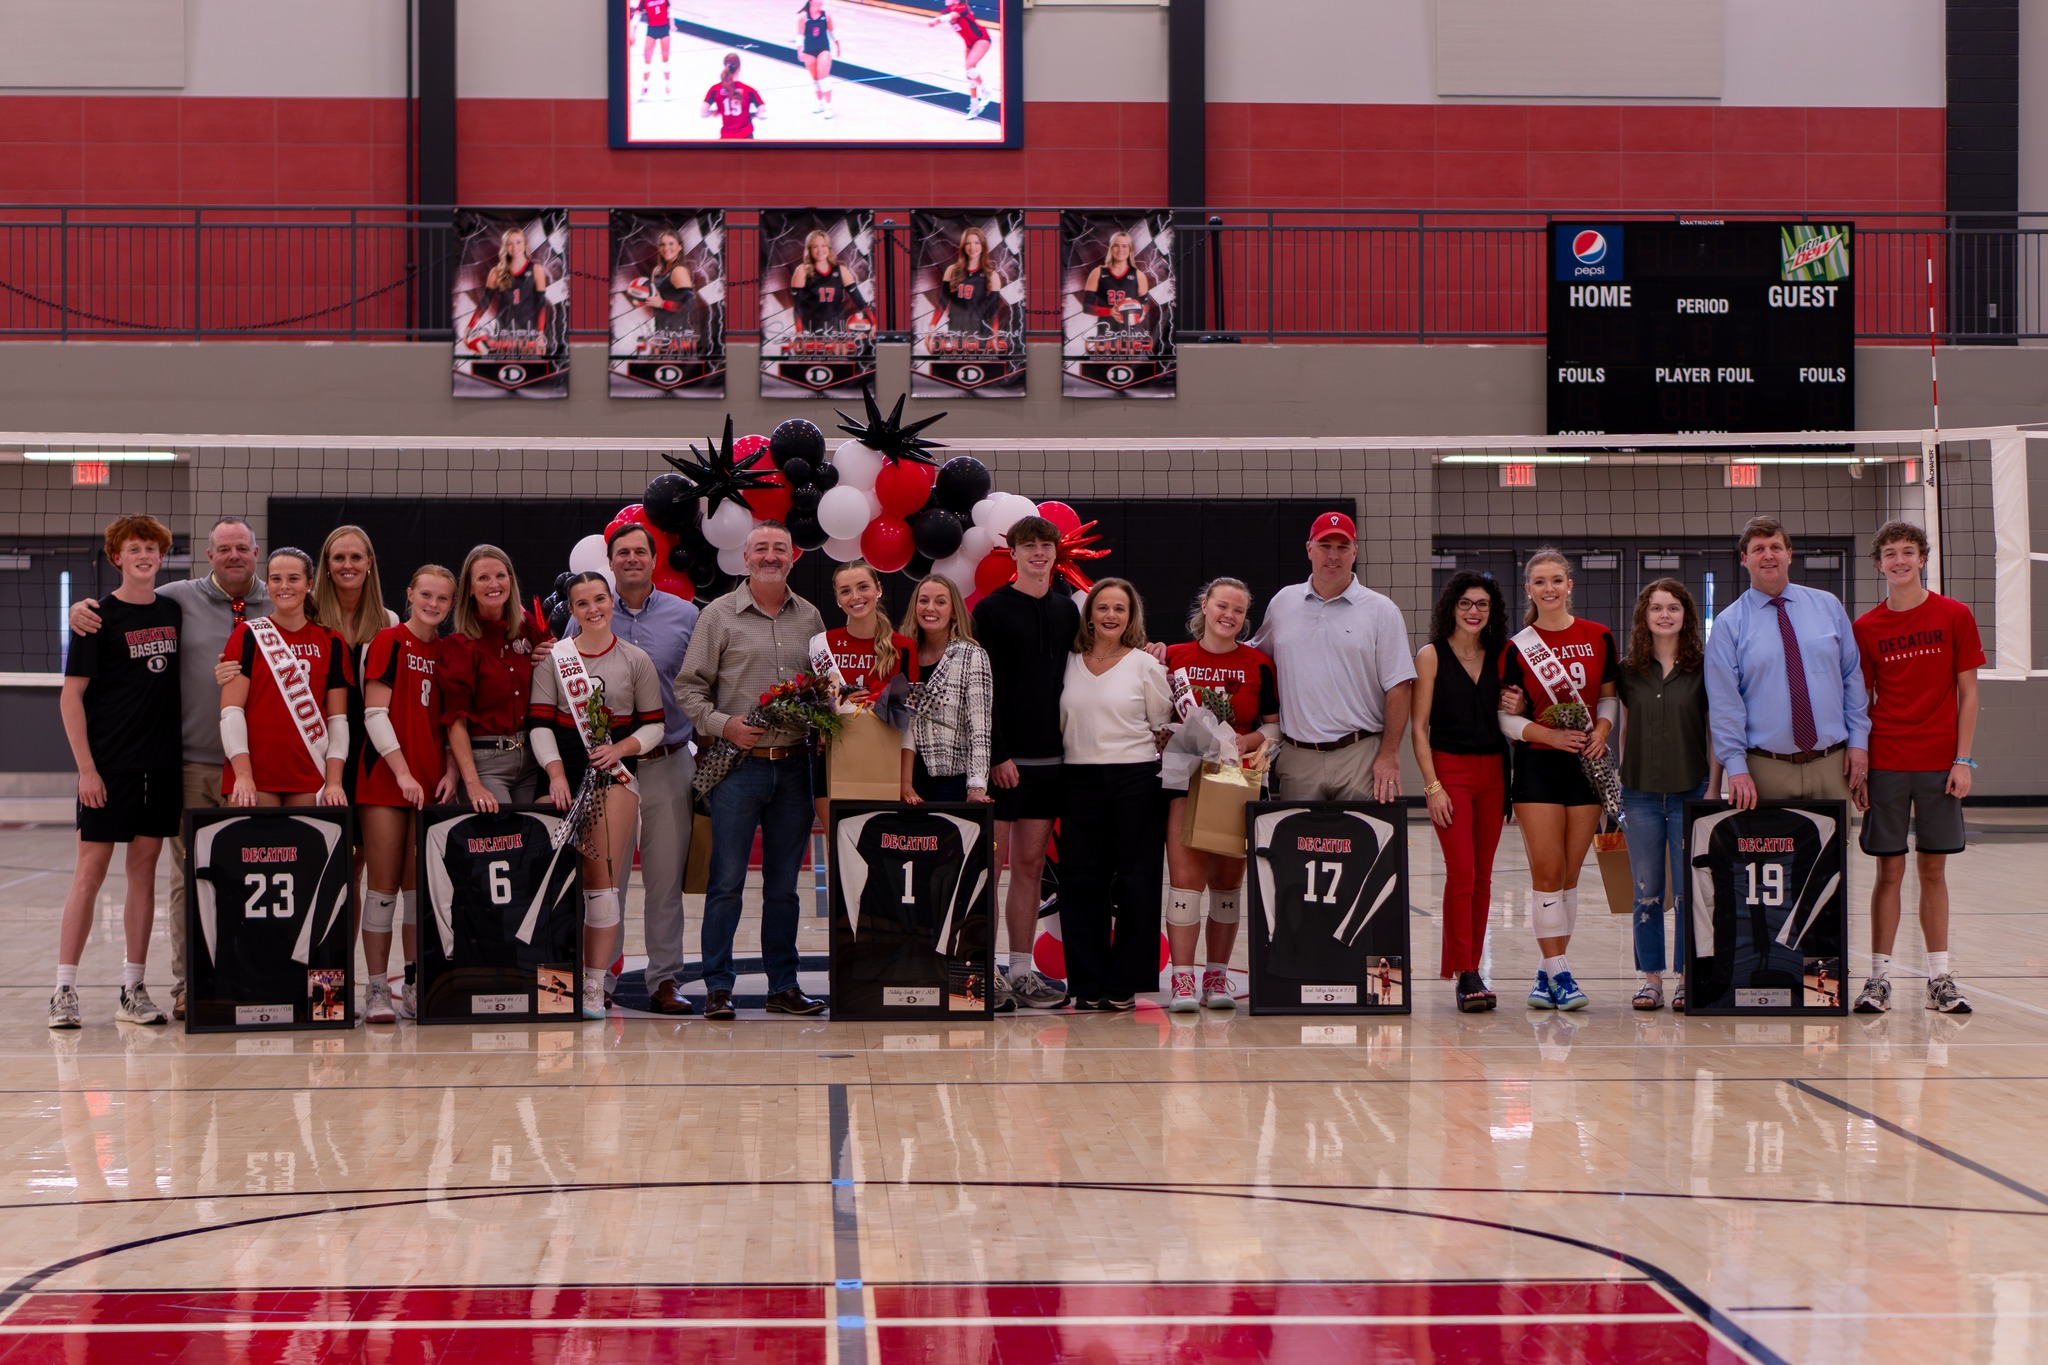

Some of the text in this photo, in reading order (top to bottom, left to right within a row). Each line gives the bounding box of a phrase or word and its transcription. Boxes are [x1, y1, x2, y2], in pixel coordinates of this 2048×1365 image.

[1574, 265, 1605, 276] pepsi
[818, 287, 835, 303] 17
[957, 283, 975, 299] 19
[1569, 285, 1632, 307] HOME
[1768, 285, 1839, 308] GUEST
[1676, 298, 1729, 314] PERIOD
[931, 335, 1008, 356] DOUGLAS
[1558, 367, 1606, 383] FOULS
[1655, 367, 1755, 383] PLAYER FOUL
[1799, 367, 1847, 383] FOULS
[77, 461, 104, 484] EXIT
[1506, 465, 1532, 486] EXIT
[1731, 465, 1757, 486] EXIT
[1523, 642, 1542, 655] CLASS
[1877, 629, 1944, 654] DECATUR
[290, 643, 321, 658] ATUR
[1552, 643, 1595, 660] CATUR
[1884, 647, 1942, 662] BASKETBALL
[557, 656, 578, 664] CLASS
[560, 665, 584, 679] 2026
[260, 632, 326, 745] SENIOR
[421, 678, 432, 707] 8
[468, 833, 523, 853] DECATUR
[881, 833, 938, 851] DECATUR
[1297, 836, 1352, 853] DECATUR
[1738, 838, 1795, 852] DECATUR
[241, 847, 298, 862] DECATUR
[488, 860, 512, 904] 6
[901, 860, 915, 904] 1
[1303, 860, 1343, 904] 17
[1745, 862, 1784, 906] 19
[244, 872, 295, 919] 23
